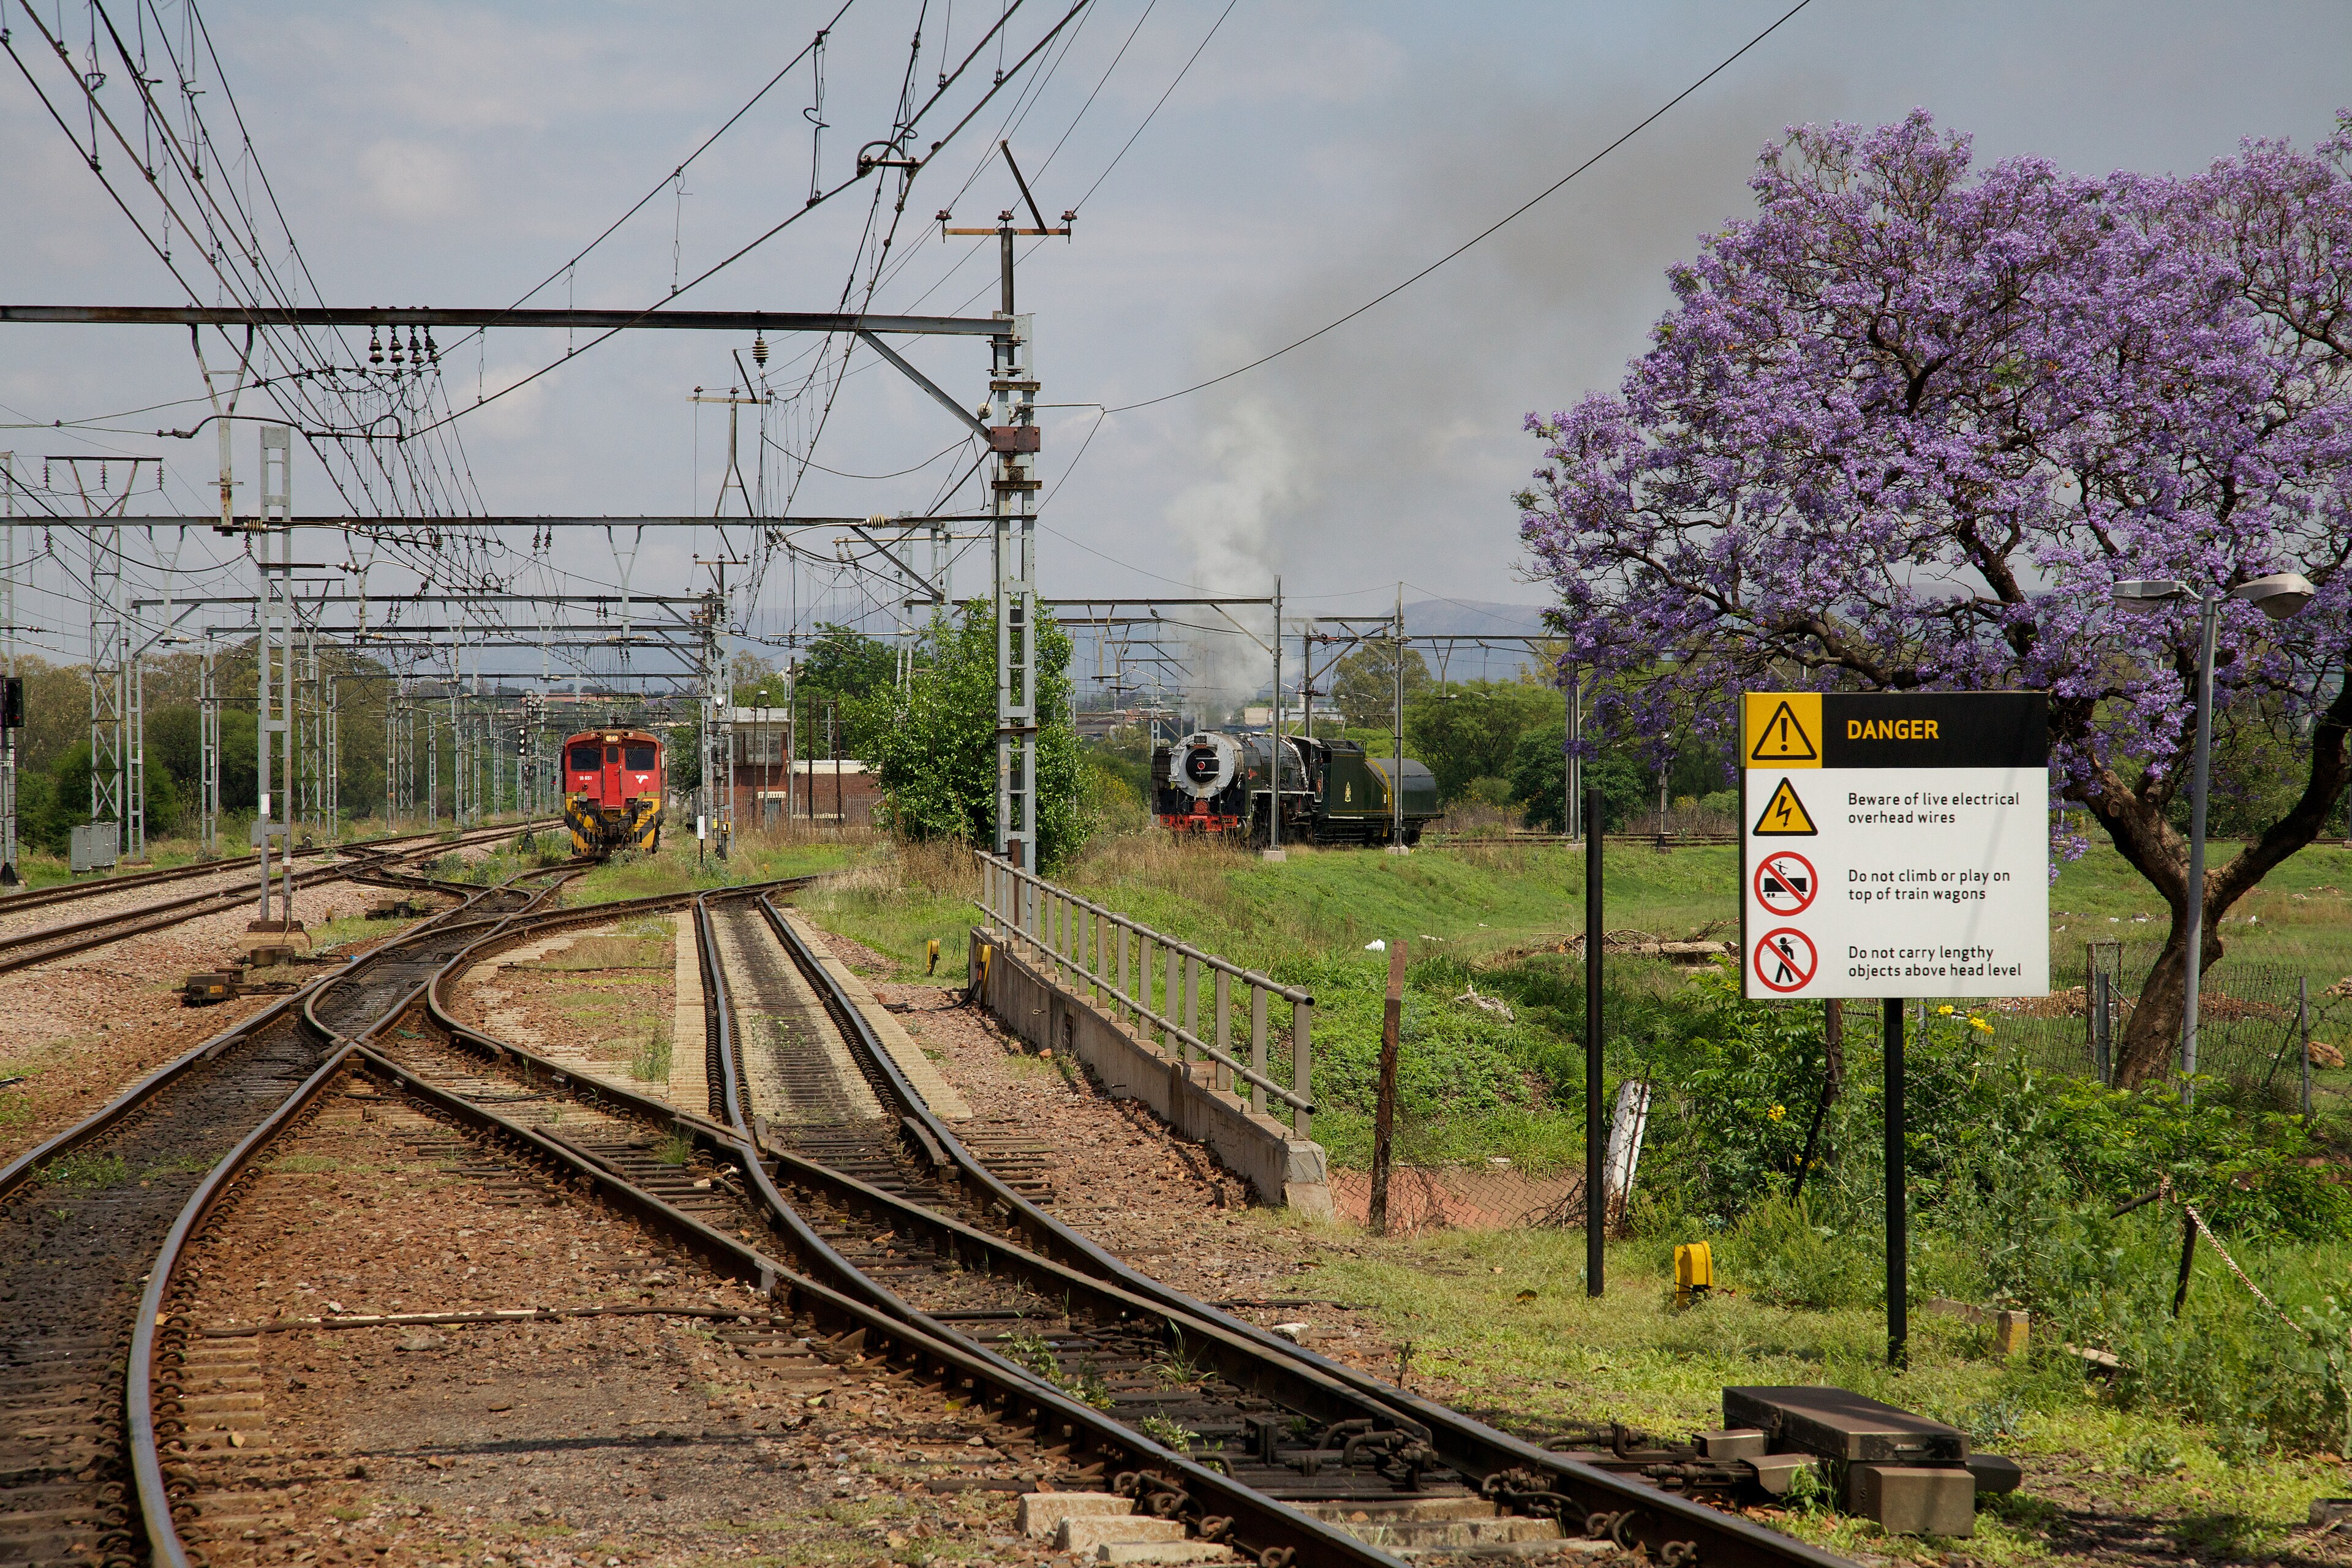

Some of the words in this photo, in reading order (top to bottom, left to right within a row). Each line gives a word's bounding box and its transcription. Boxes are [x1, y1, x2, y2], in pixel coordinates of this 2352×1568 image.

[1847, 719, 1939, 739] DANGER
[1849, 792, 1900, 805] Beware
[1904, 792, 1919, 805] of
[1923, 792, 1948, 805] live
[1952, 792, 2019, 805] electrical
[1849, 810, 1913, 824] overhead
[1917, 810, 1955, 824] wires
[1849, 869, 1867, 882] Do
[1871, 871, 1894, 882] not
[1899, 869, 1937, 882] climb
[1941, 872, 1956, 882] or
[1960, 869, 1989, 886] play
[1993, 872, 2010, 882] on
[1848, 889, 1872, 904] top
[1876, 887, 1891, 900] of
[1894, 887, 1929, 900] train
[1933, 890, 1986, 903] wagons
[1849, 946, 1867, 959] Do
[1871, 948, 1895, 959] not
[1899, 949, 1936, 962] carry
[1940, 945, 1994, 962] lengthy
[1849, 963, 1901, 981] objects
[1905, 963, 1946, 976] above
[1950, 963, 1984, 976] head
[1988, 963, 2021, 976] level
